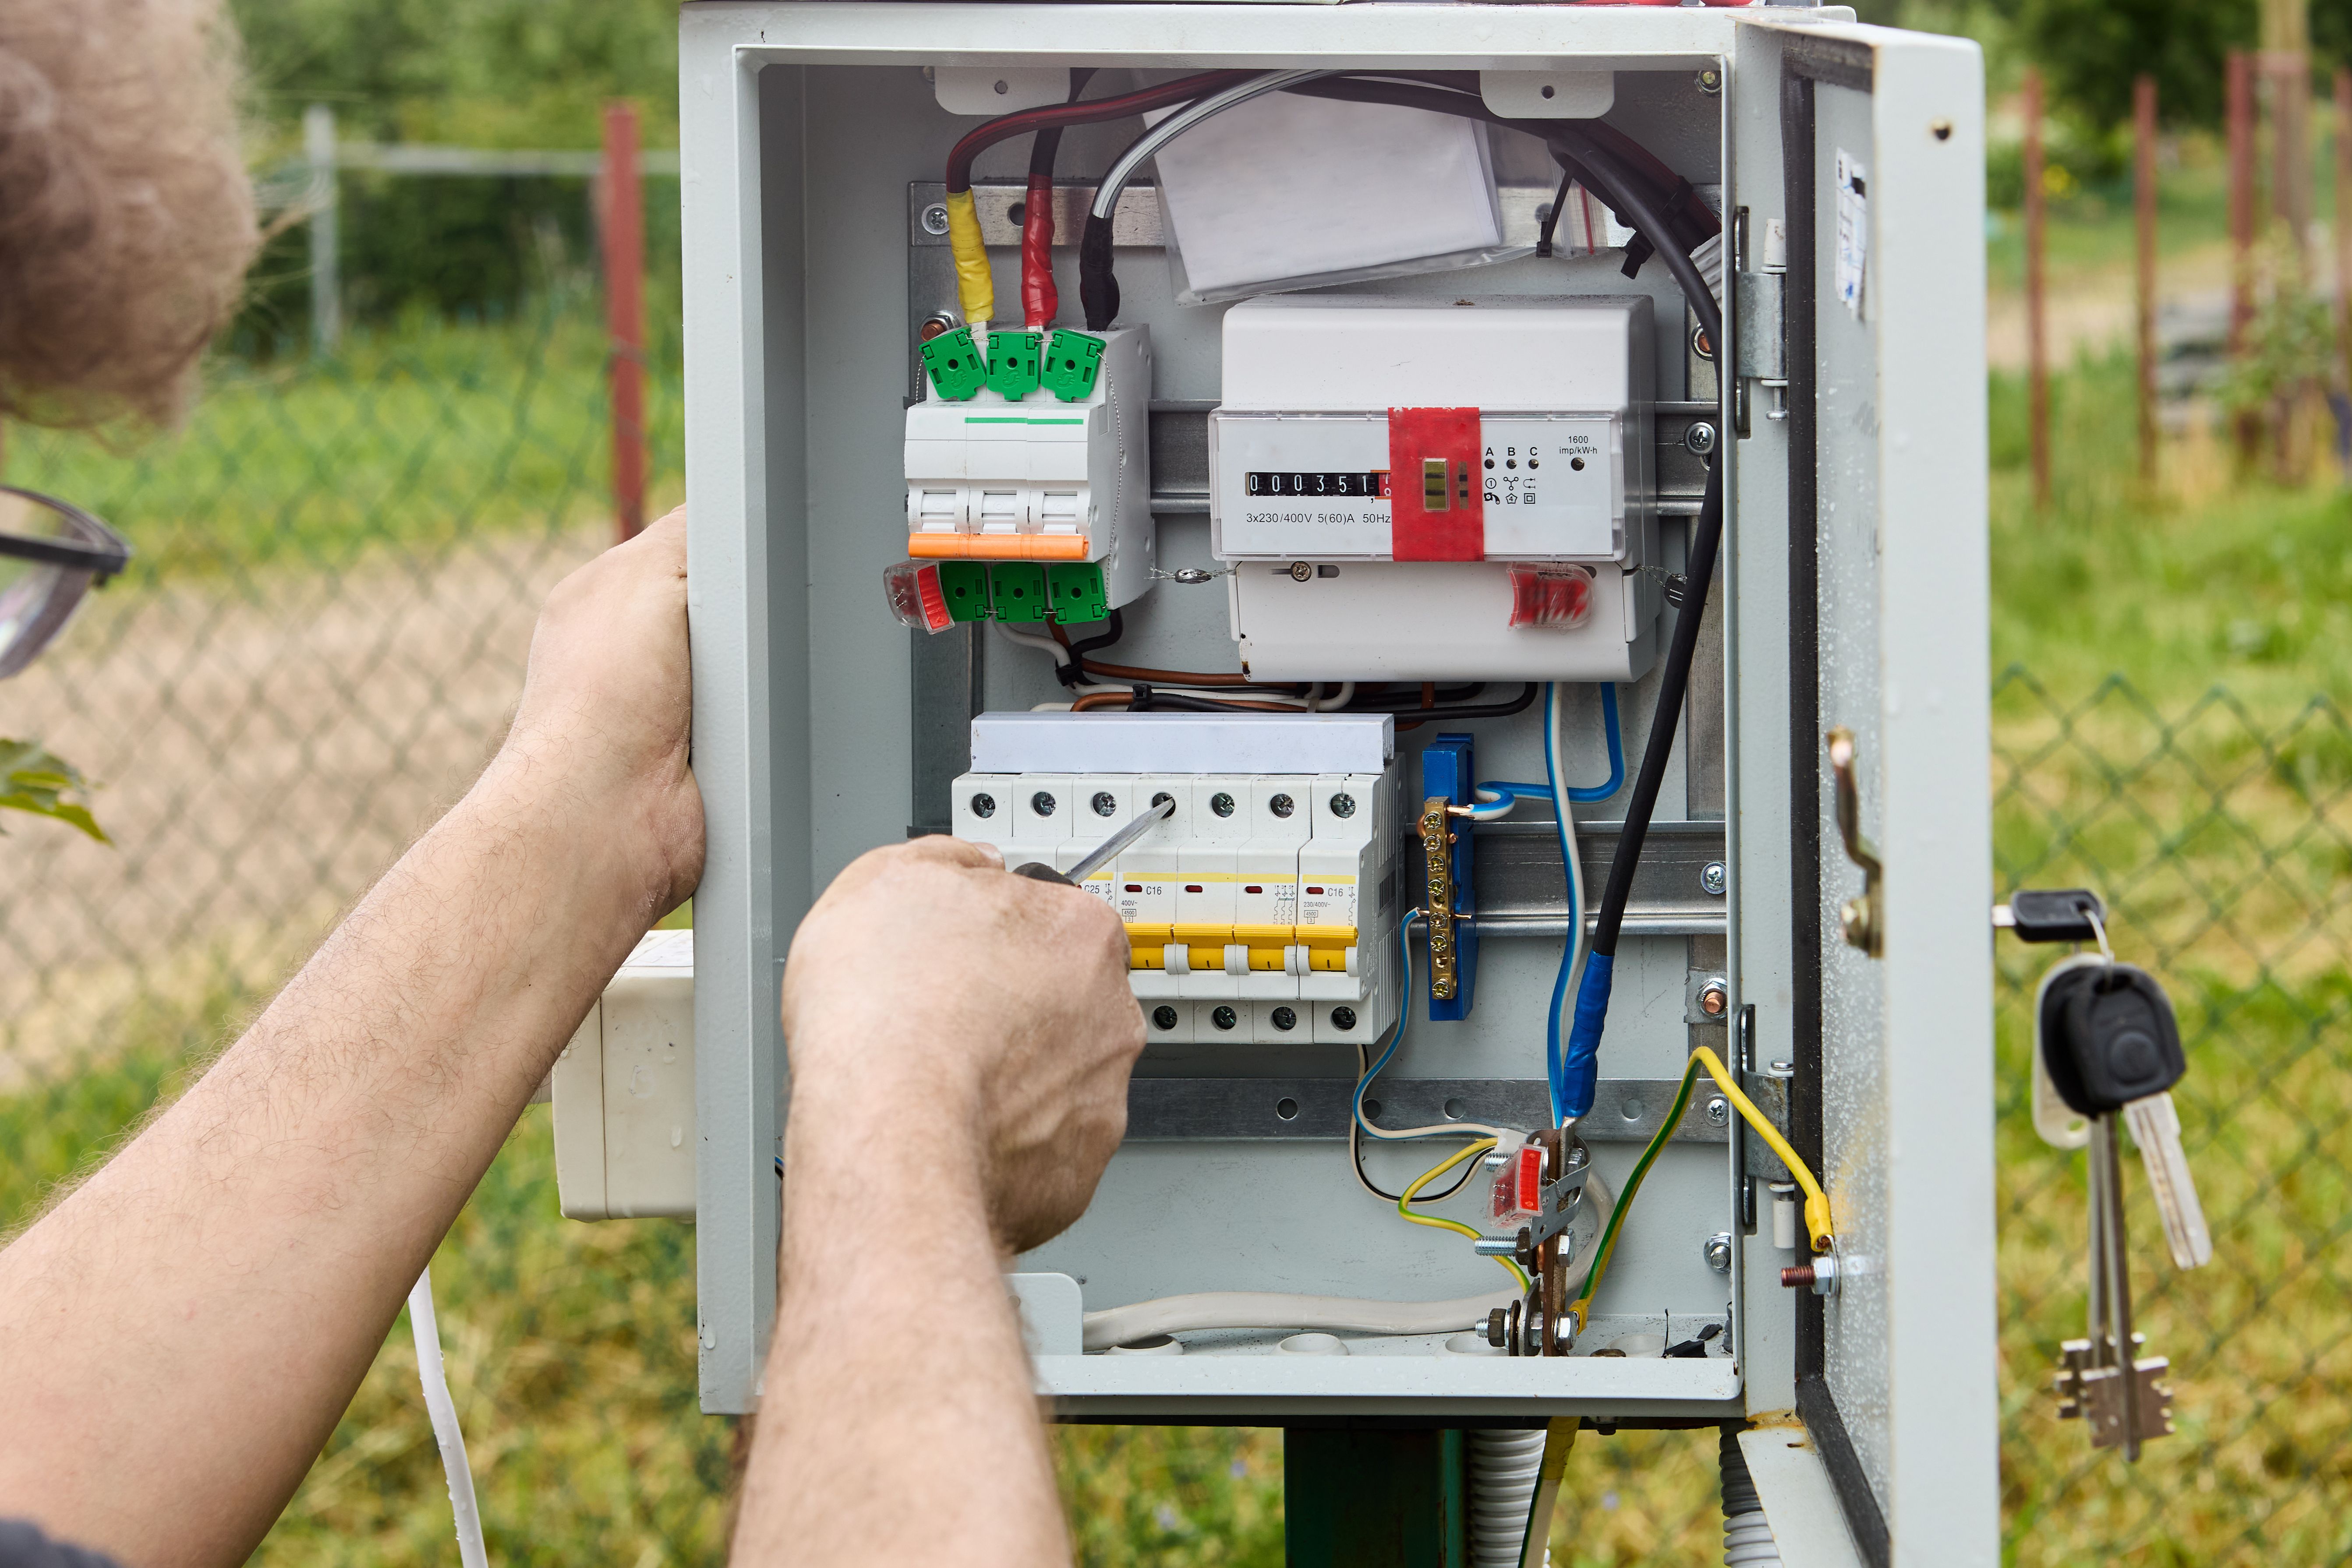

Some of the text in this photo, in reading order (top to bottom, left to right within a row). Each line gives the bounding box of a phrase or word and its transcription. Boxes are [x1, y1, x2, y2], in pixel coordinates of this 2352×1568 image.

[1485, 447, 1538, 456] A B C
[1246, 513, 1391, 525] 3x230/400V 5(60)A 50Hz
[1084, 885, 1100, 894] C25
[1146, 886, 1162, 895] C16
[1328, 888, 1343, 897] C16
